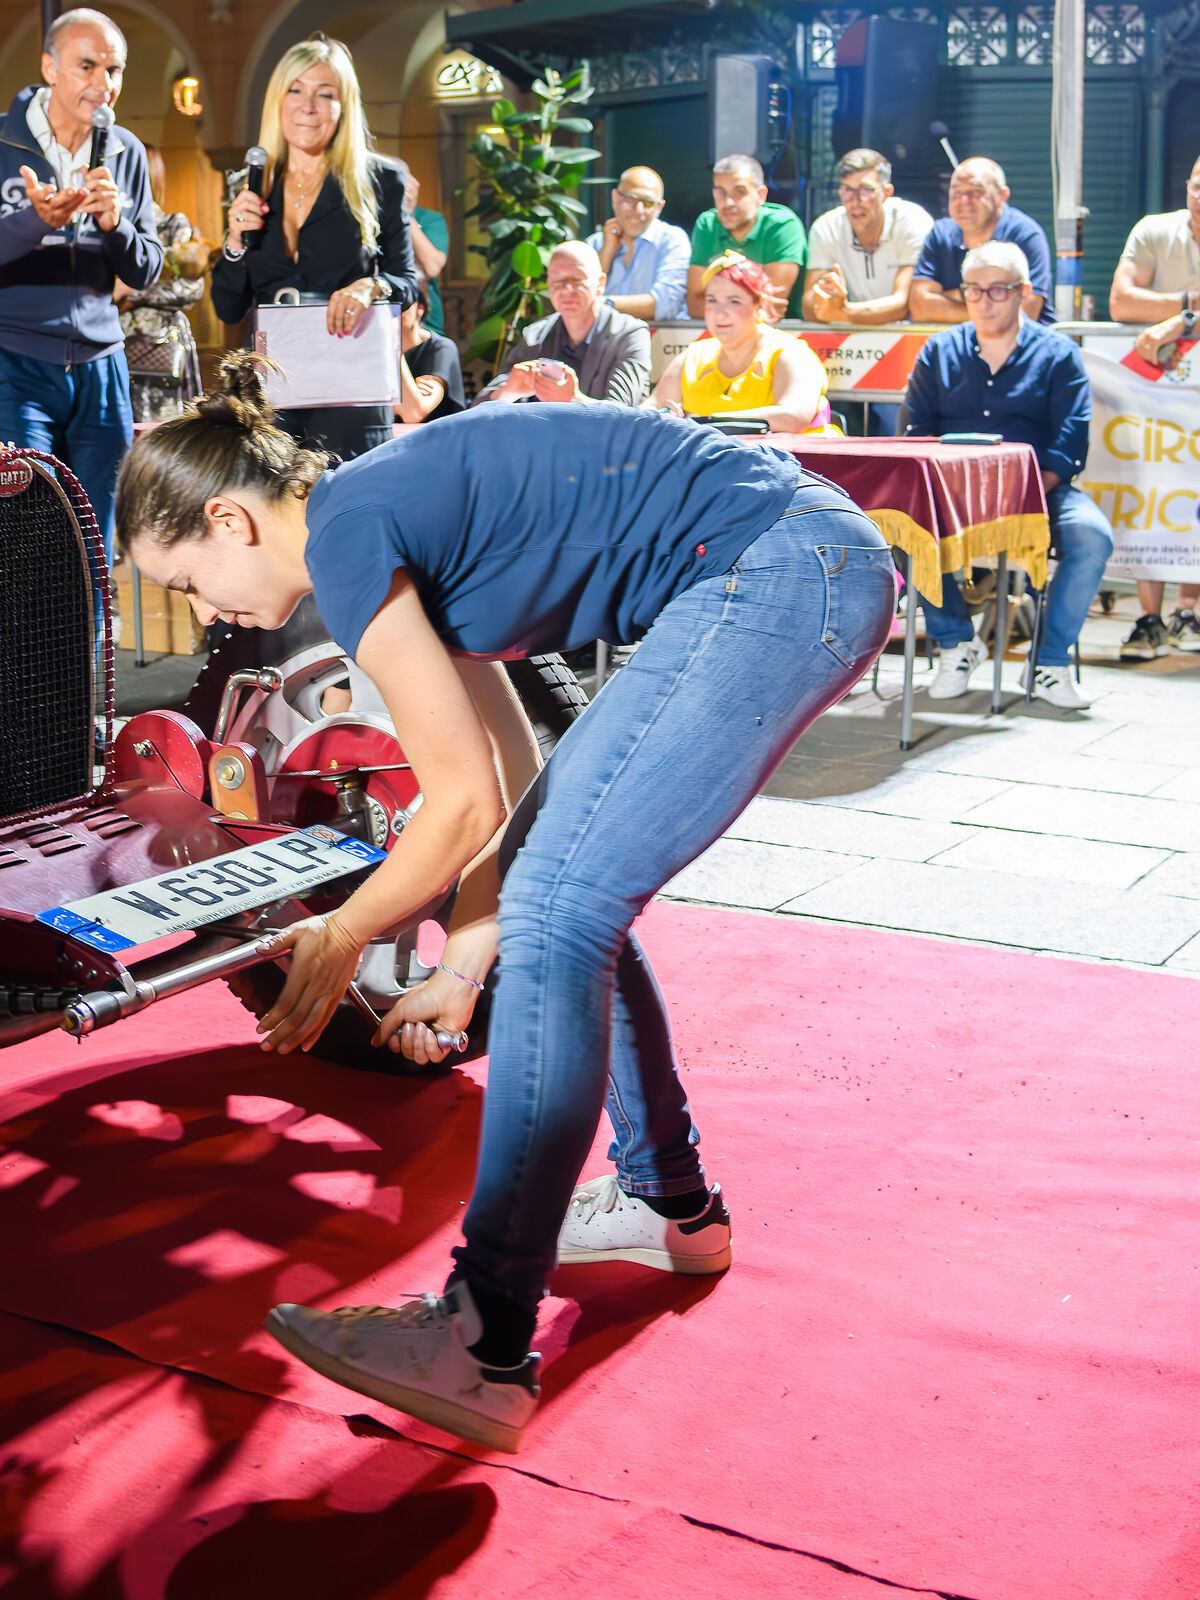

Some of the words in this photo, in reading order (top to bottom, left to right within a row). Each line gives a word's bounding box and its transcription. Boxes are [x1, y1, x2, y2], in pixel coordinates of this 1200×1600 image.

[818, 348, 885, 361] FERRATO
[1082, 481, 1200, 532] TRIC
[340, 840, 376, 858] 67
[111, 838, 330, 922] W-630-LP
[89, 931, 107, 942] F
